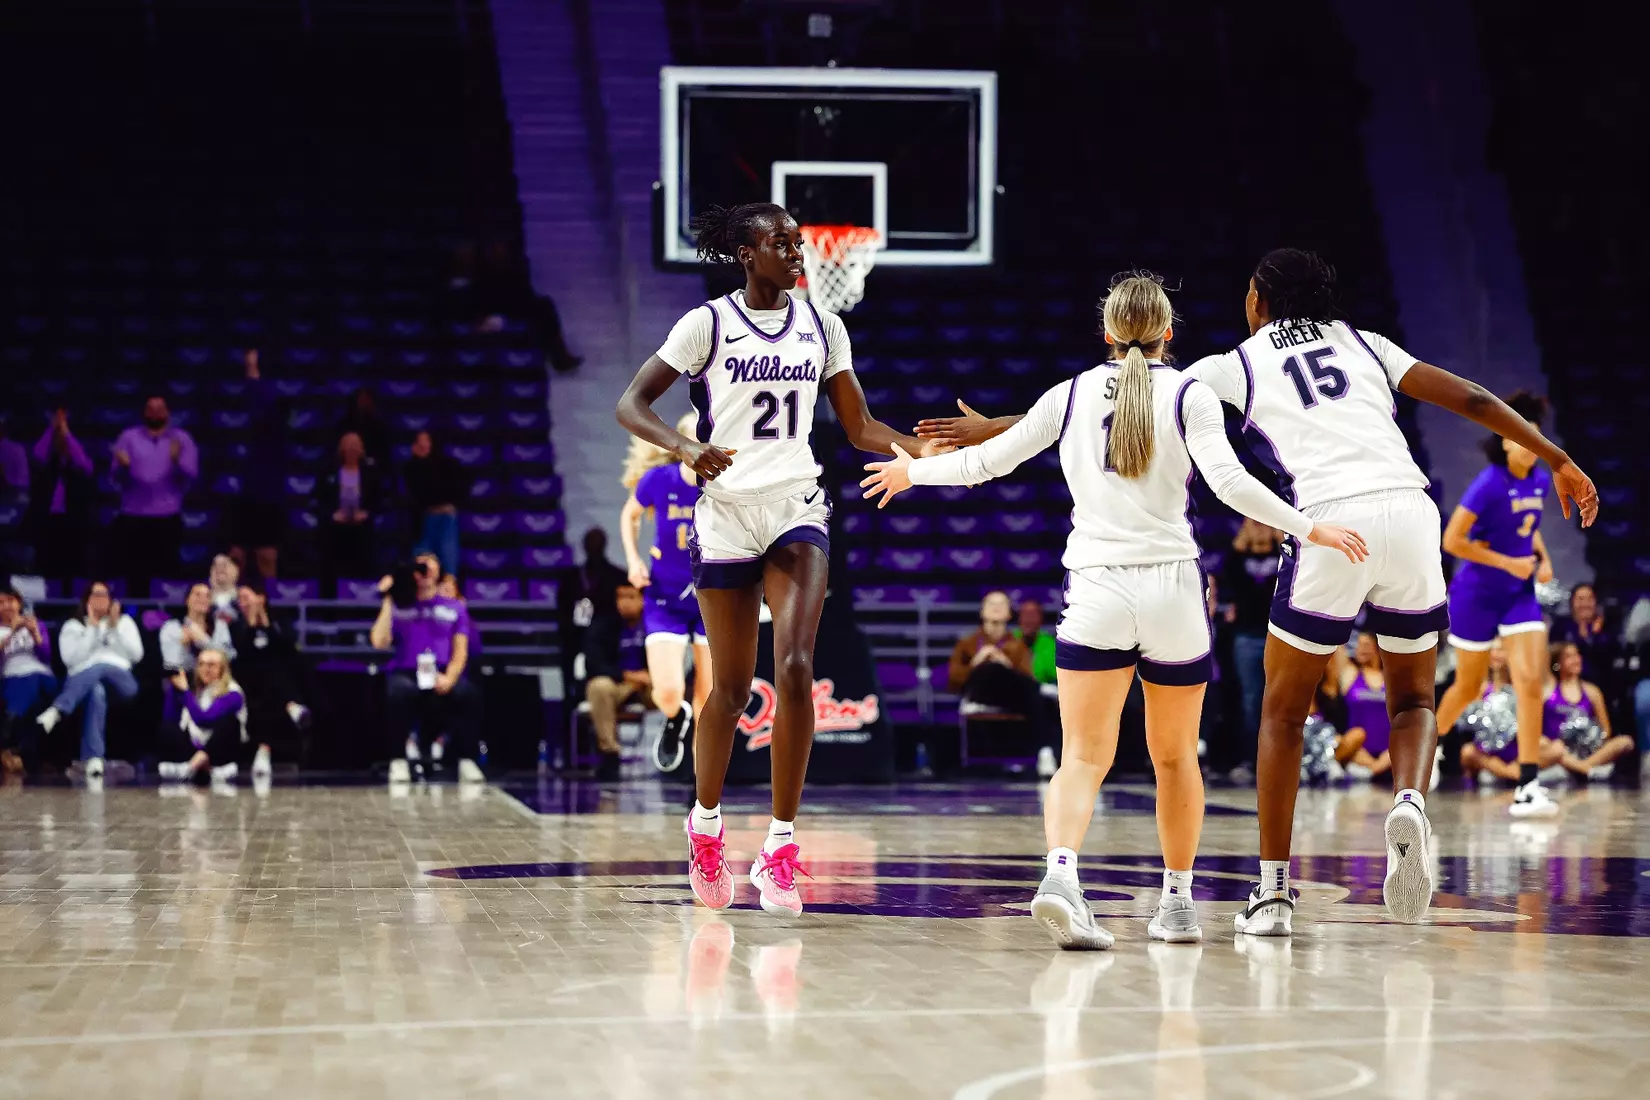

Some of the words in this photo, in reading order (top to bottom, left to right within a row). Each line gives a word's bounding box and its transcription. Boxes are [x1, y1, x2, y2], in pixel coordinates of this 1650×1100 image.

[1269, 323, 1324, 349] GREEN
[725, 354, 817, 384] Wildcats
[1281, 345, 1351, 410] 15
[751, 389, 799, 440] 21
